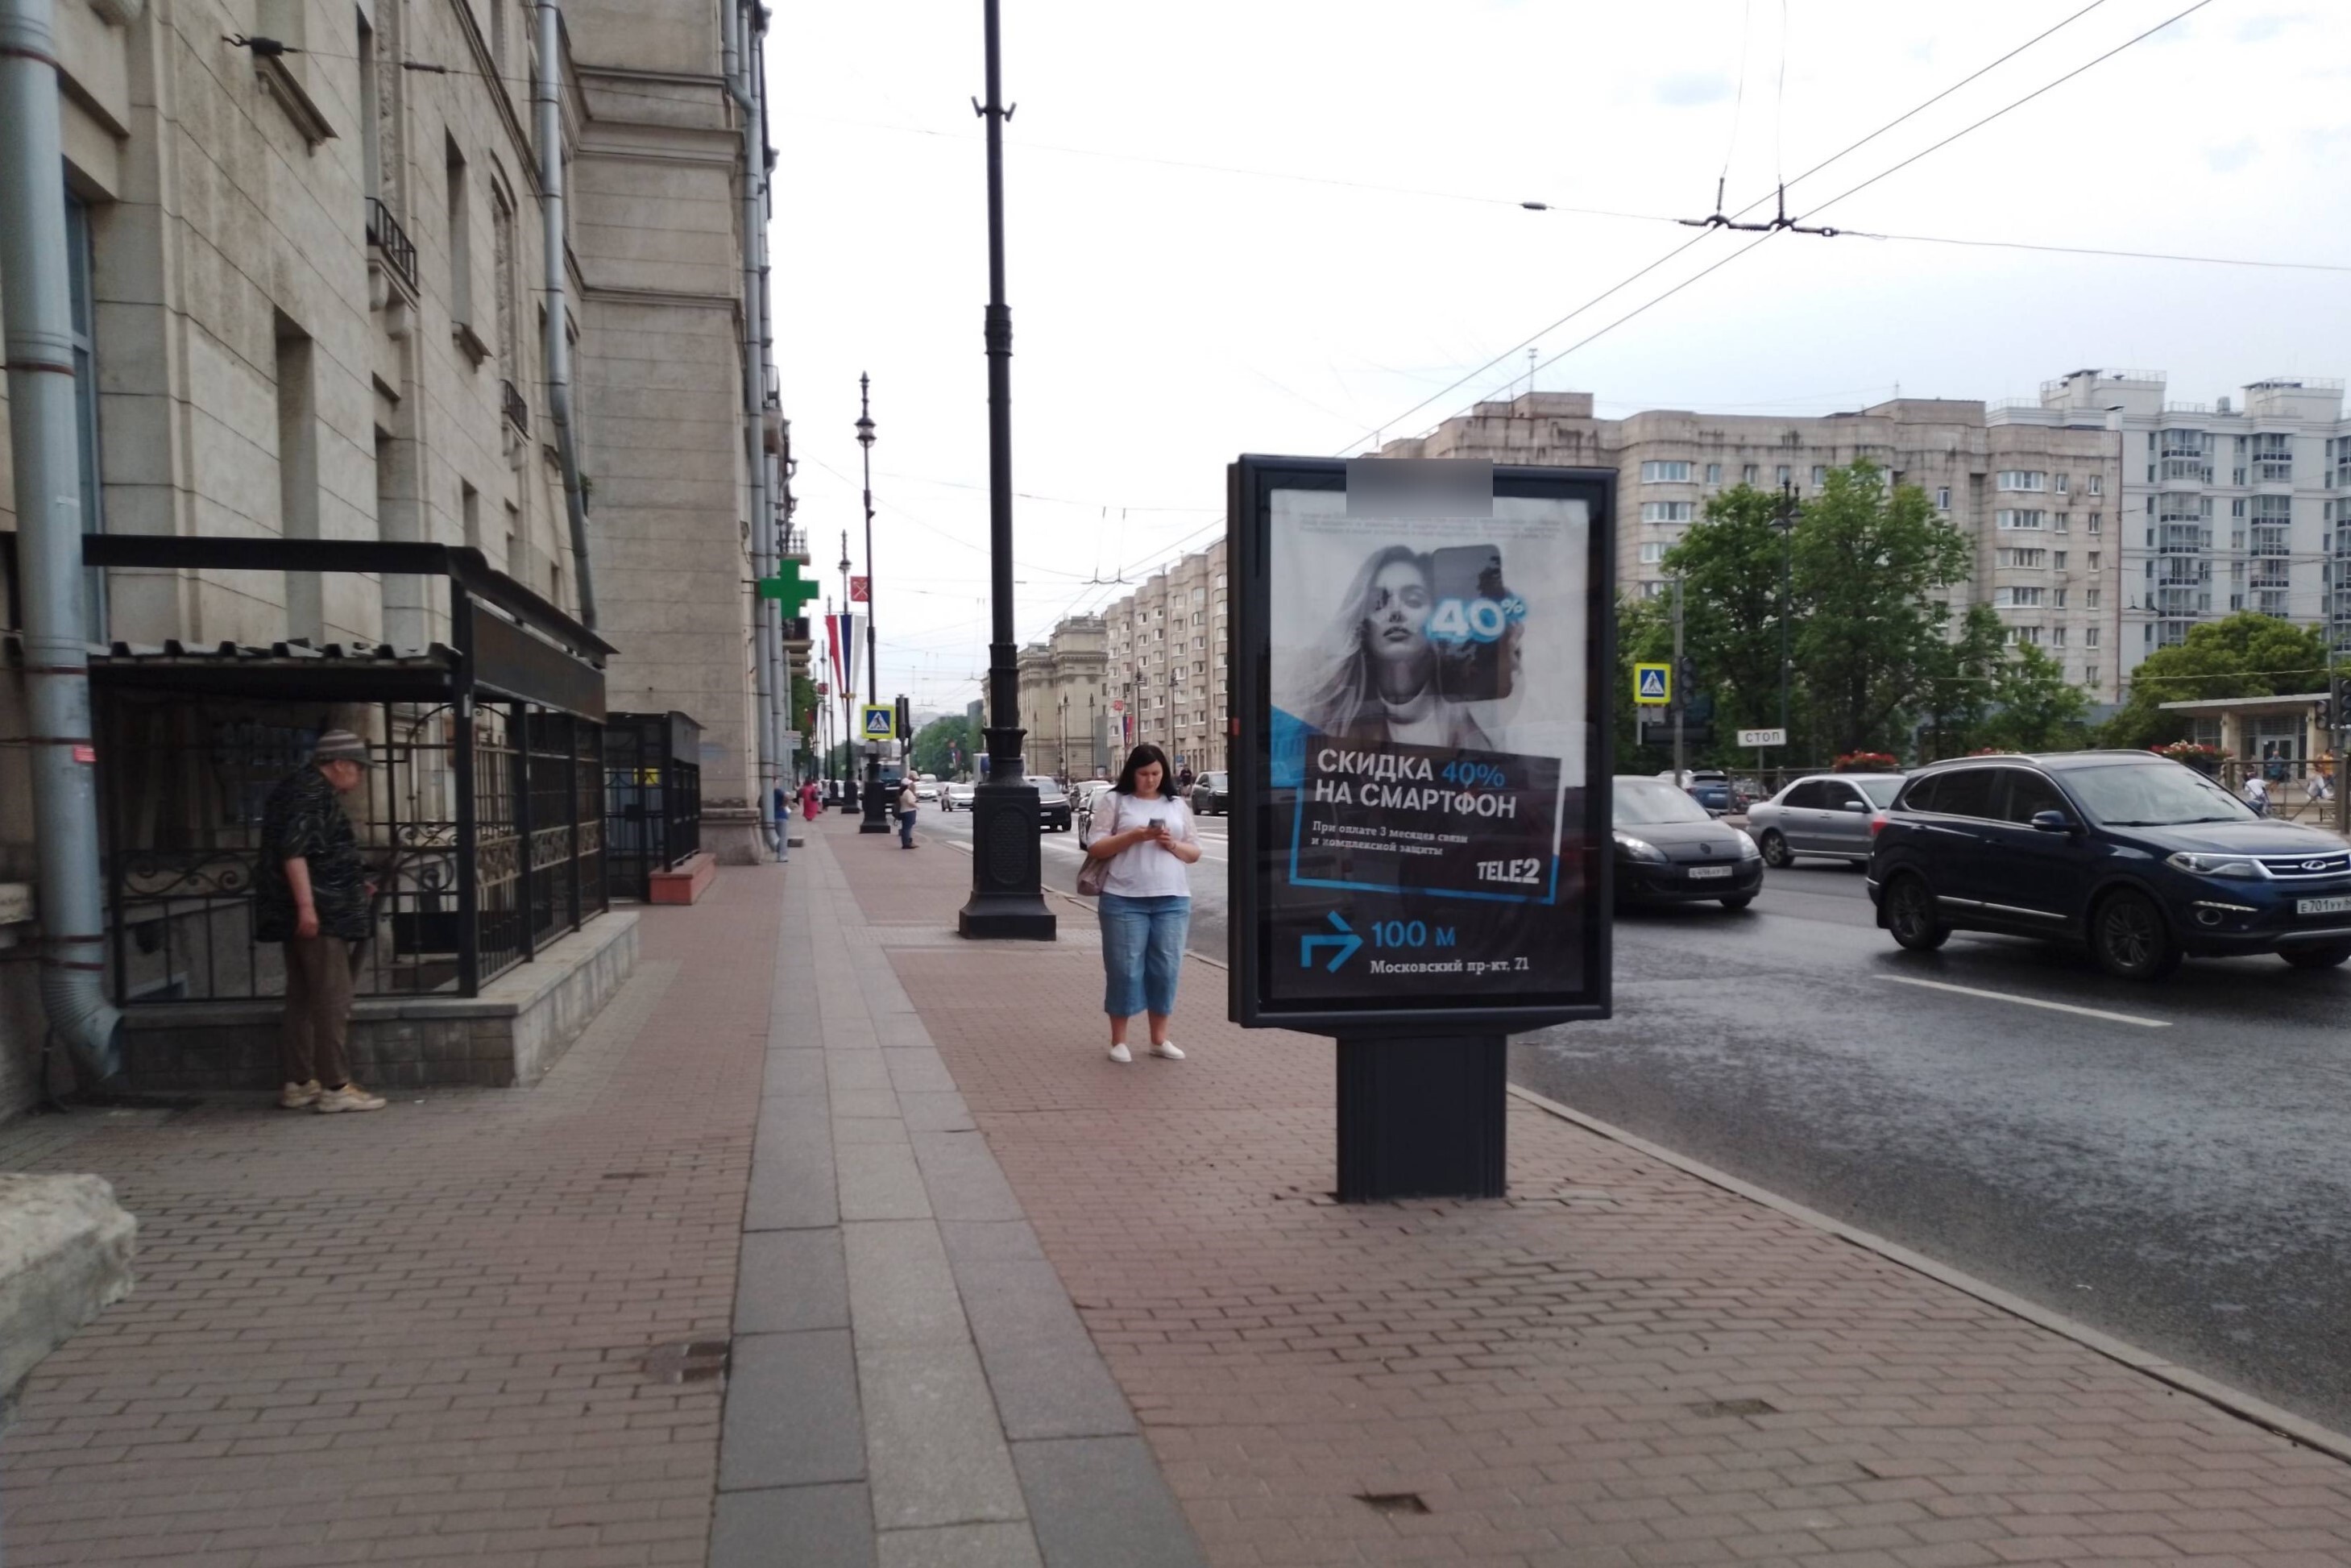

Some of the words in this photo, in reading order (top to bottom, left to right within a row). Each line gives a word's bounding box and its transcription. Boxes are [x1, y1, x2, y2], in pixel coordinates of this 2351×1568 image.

[1431, 598, 1524, 637] 40%
[1746, 732, 1780, 742] СТОП
[1317, 749, 1433, 782] СКИДКА
[1441, 761, 1505, 786] 40%
[1315, 778, 1353, 804] НА
[1360, 783, 1516, 819] СМАРТФОН
[1312, 820, 1336, 835] При
[1338, 826, 1377, 836] оплате
[1380, 826, 1387, 836] 3
[1389, 830, 1435, 841] месяцев
[1312, 837, 1319, 845] и
[1322, 839, 1396, 852] комплексной
[1399, 844, 1444, 856] защиты
[1477, 858, 1540, 885] TELE2
[1371, 920, 1426, 948] 100
[1370, 959, 1462, 973] Московский
[1467, 960, 1511, 975] пр-кт,
[1515, 957, 1529, 970] 71
